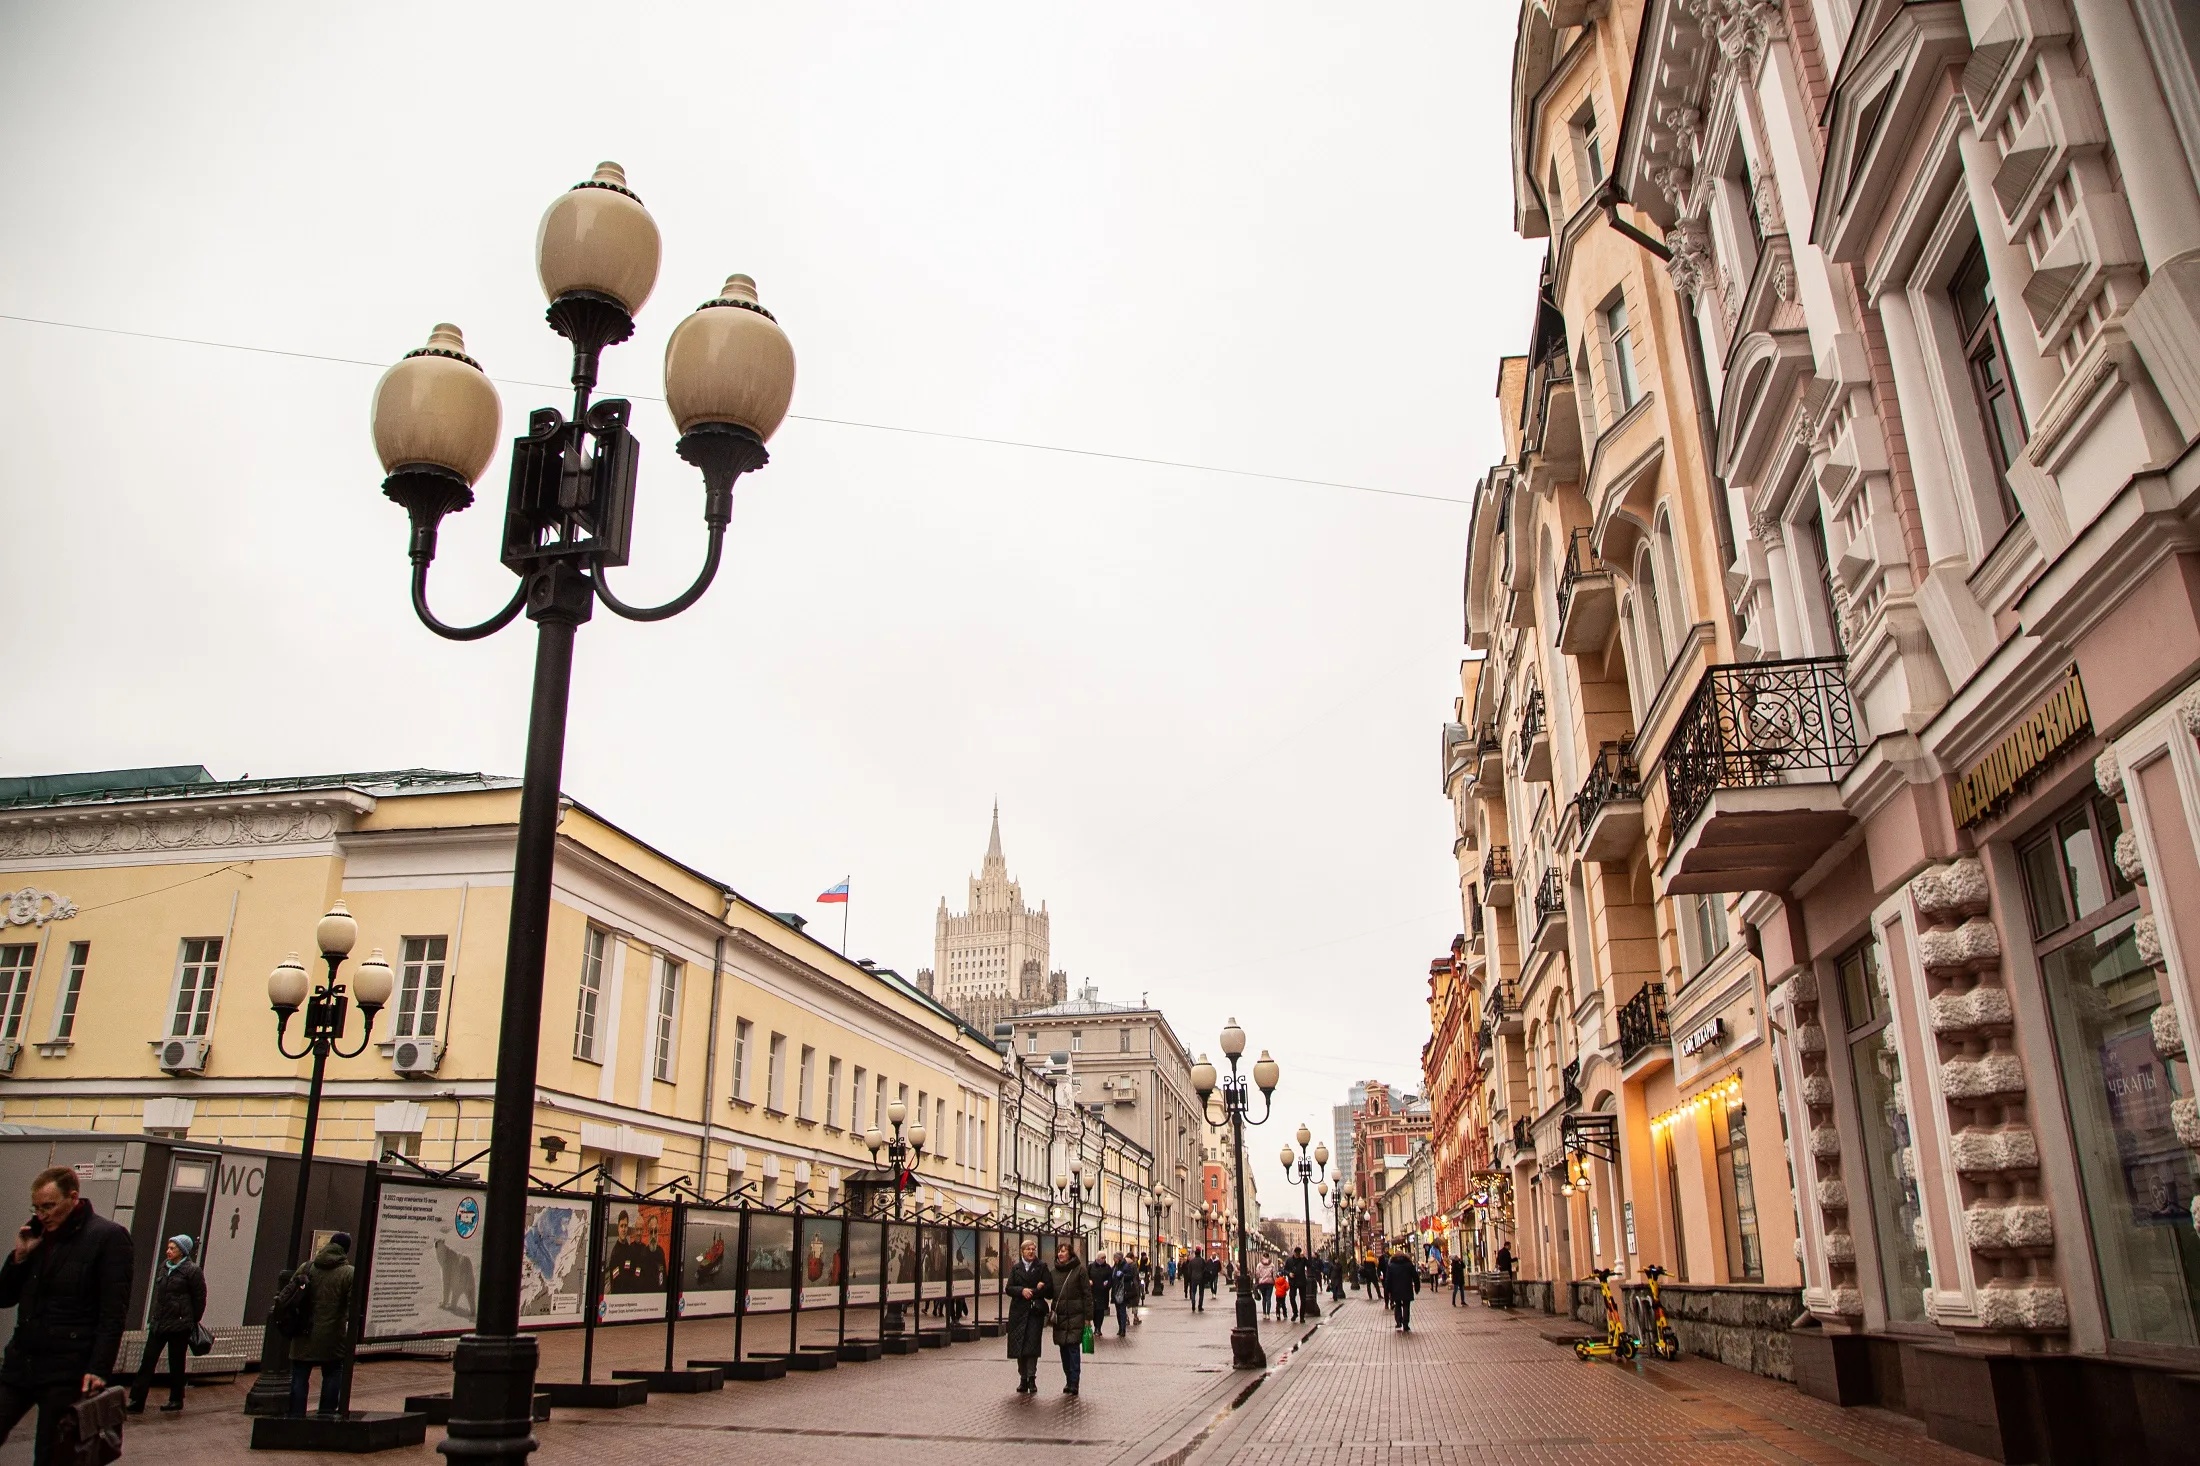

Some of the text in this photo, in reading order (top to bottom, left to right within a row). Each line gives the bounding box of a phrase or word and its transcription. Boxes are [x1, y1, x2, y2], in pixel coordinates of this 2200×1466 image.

[1951, 664, 2088, 829] МЕДИЦИНСКИЙ
[2108, 1071, 2157, 1097] ЧЕКАПЫ
[221, 1164, 264, 1197] WC
